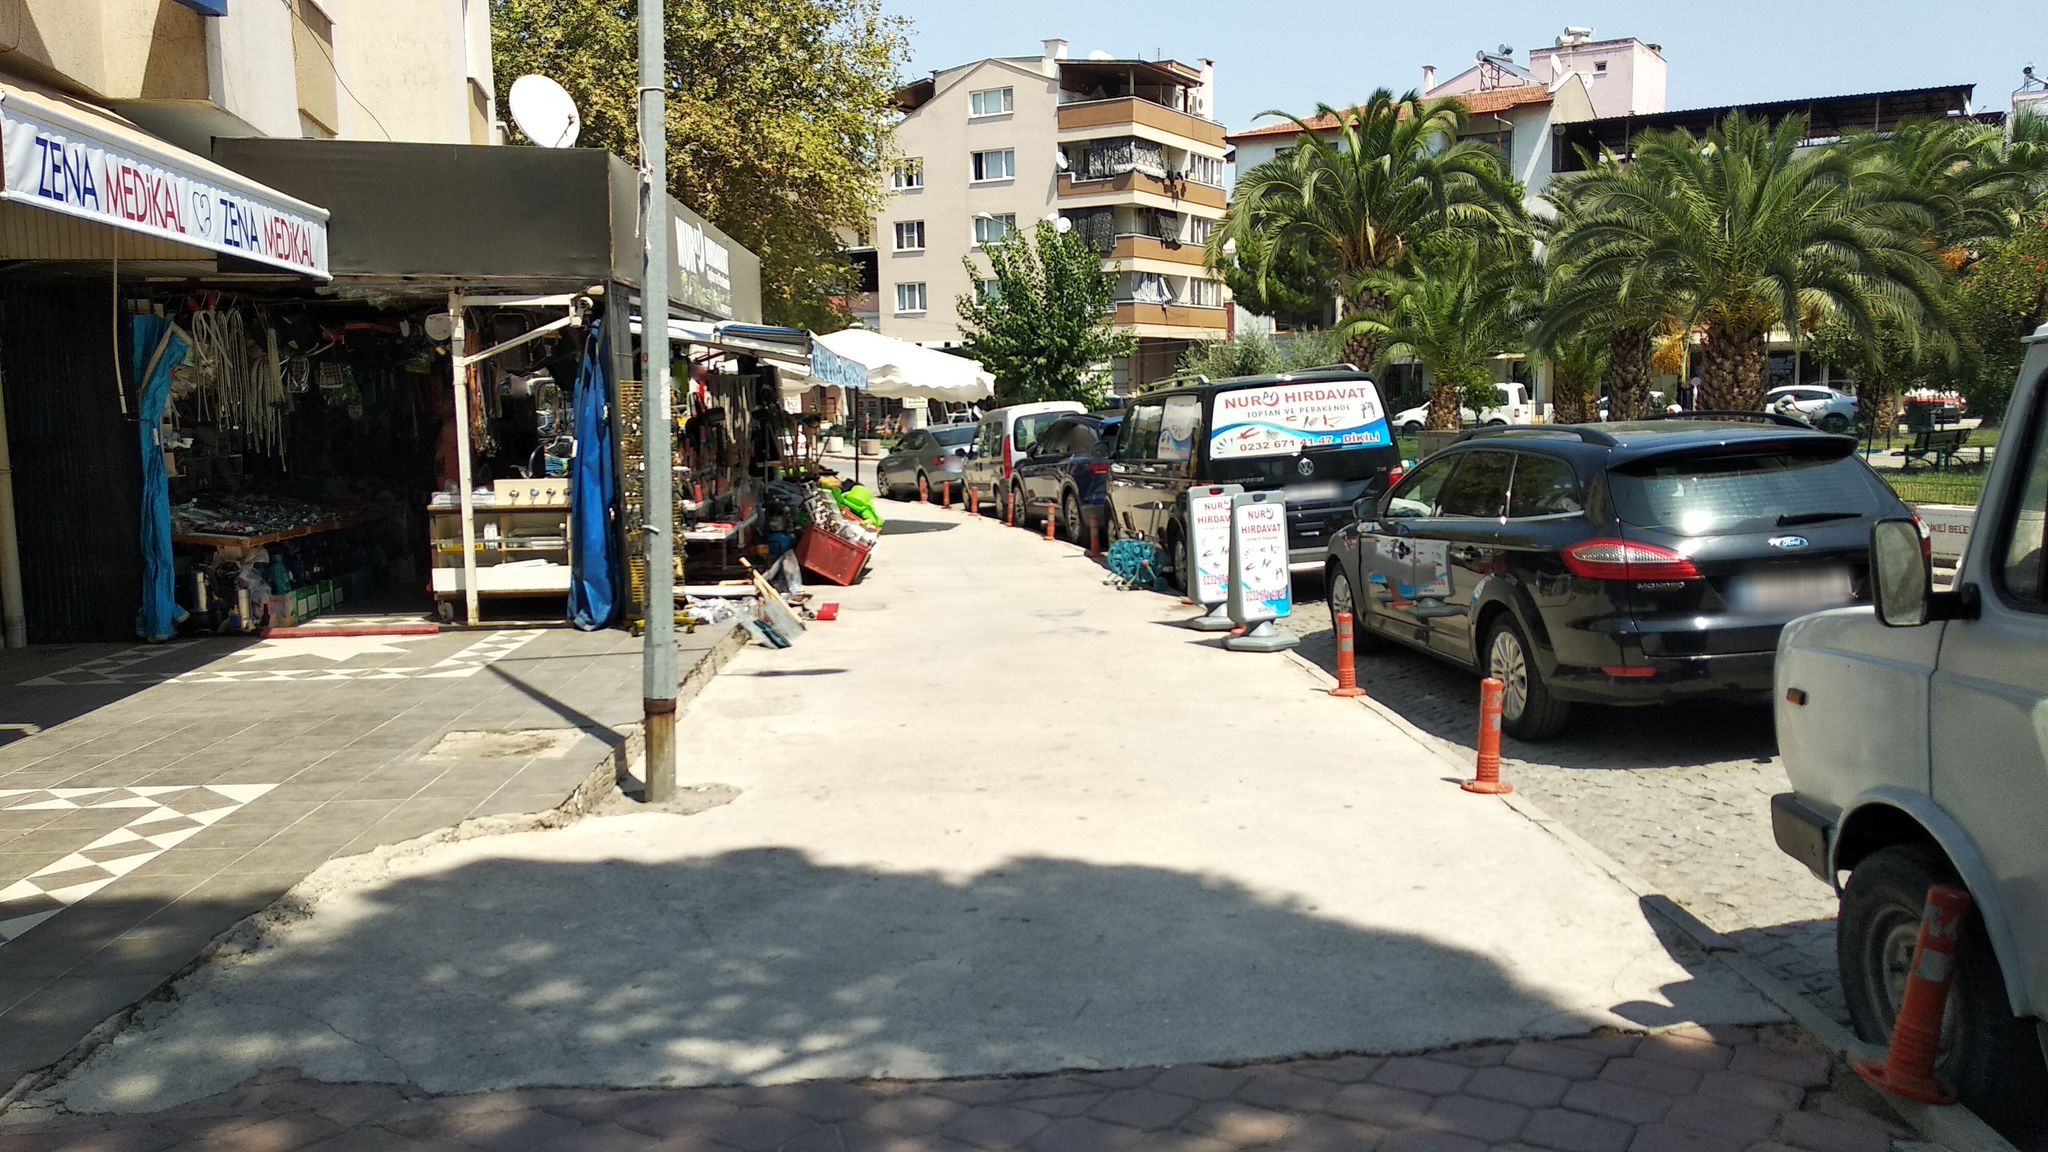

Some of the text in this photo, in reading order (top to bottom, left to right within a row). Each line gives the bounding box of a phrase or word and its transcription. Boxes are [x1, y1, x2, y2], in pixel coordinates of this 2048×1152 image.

[35, 136, 100, 211] ZENA
[219, 198, 261, 252] ZENA
[1284, 387, 1366, 404] HIRDAVAT
[1284, 407, 1295, 415] VE
[1299, 403, 1351, 414] PERAKENDE
[1239, 441, 1270, 452] 0232
[1274, 439, 1295, 449] 671
[1300, 437, 1314, 447] 41
[1317, 436, 1333, 445] 47
[1241, 523, 1281, 534] HIRDAVAT
